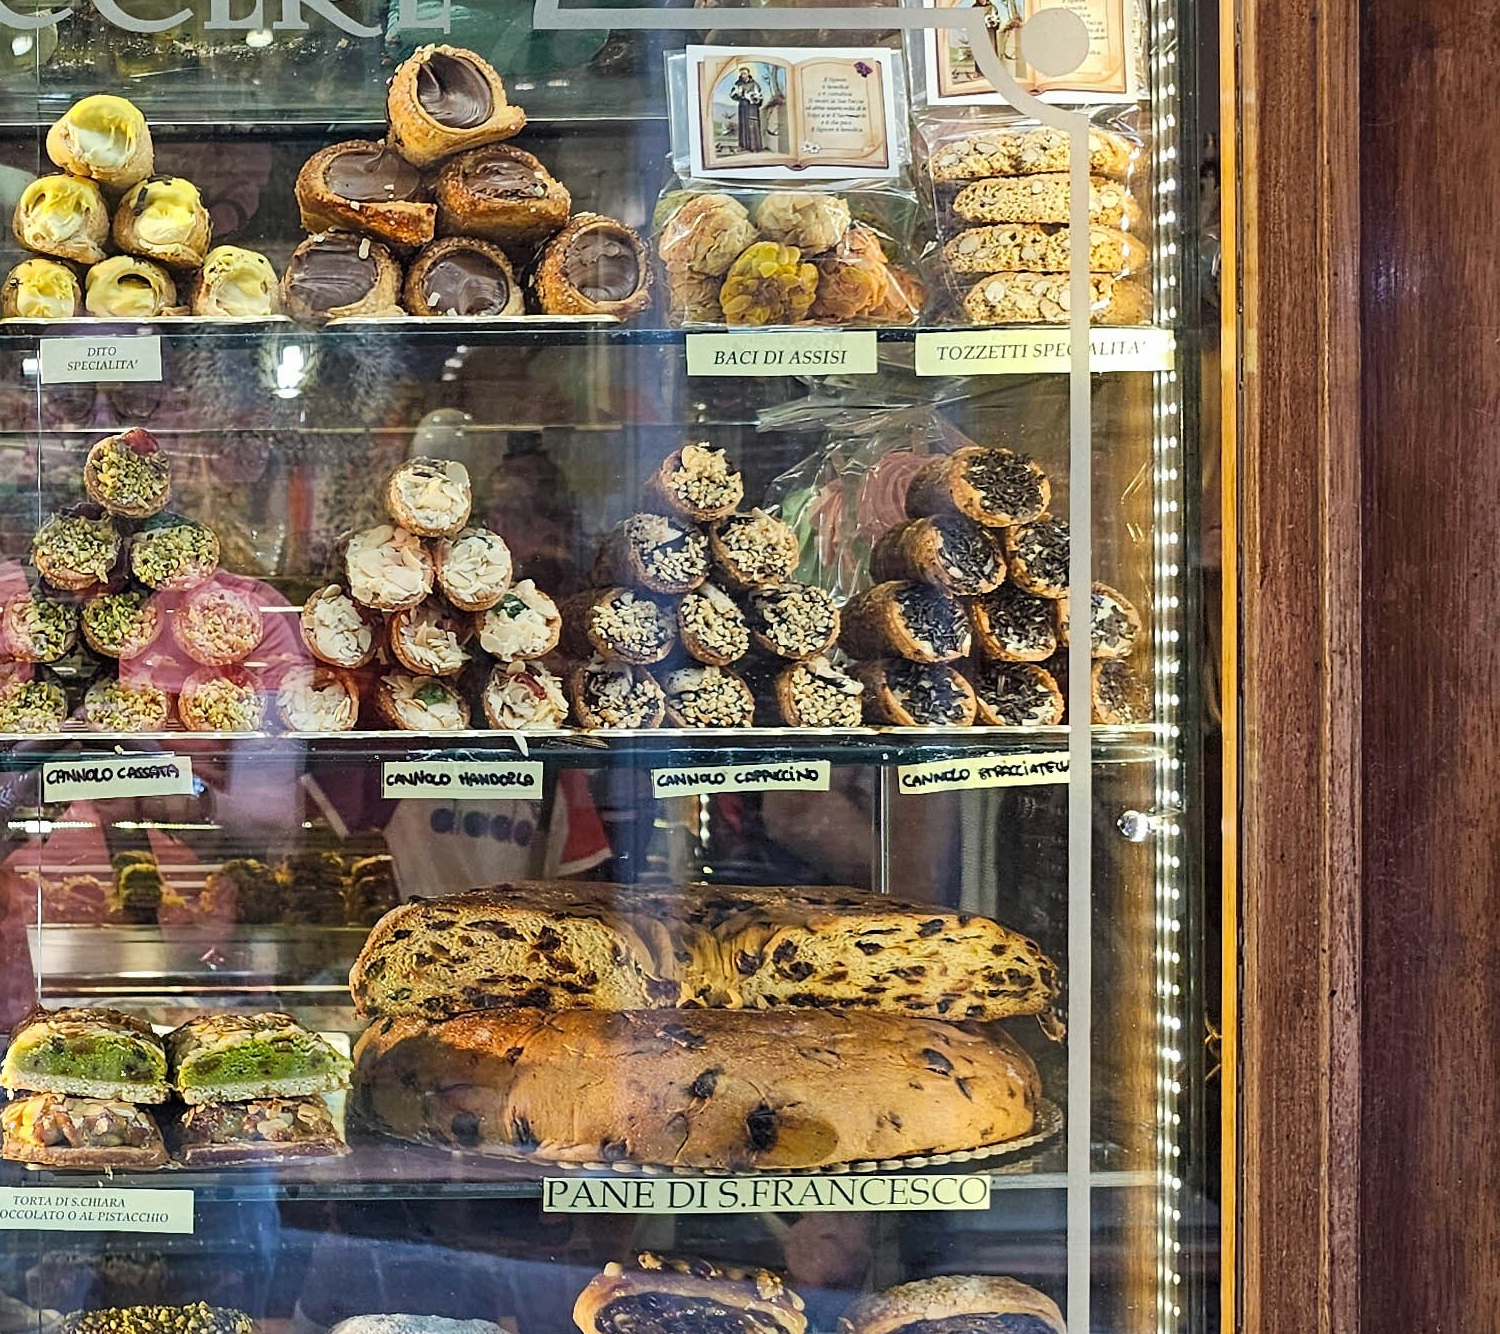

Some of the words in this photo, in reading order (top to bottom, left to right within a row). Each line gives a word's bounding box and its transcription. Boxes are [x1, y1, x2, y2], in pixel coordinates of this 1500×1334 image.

[87, 346, 117, 358] DITO
[713, 349, 758, 365] BACI
[763, 349, 784, 365] DI
[787, 348, 848, 365] ASSISI
[936, 343, 1028, 361] TOZZETTI
[66, 359, 139, 371] SPECIALITA'
[46, 768, 114, 785] CANNOLO
[116, 764, 180, 779] CASSATA
[385, 770, 452, 787] CANNOLO
[458, 771, 535, 787] MANDORLA
[656, 771, 726, 787] CANNOLO
[734, 766, 819, 784] CAPPUCCINO
[902, 768, 971, 788] CANNOLO
[546, 1179, 655, 1209] PANE
[668, 1178, 708, 1207] DI
[717, 1174, 989, 1208] S.FRANCESCO
[13, 1195, 52, 1206] TORTA
[55, 1196, 69, 1206] DI
[70, 1196, 126, 1208] S.CHIARA
[67, 1209, 77, 1220] O
[79, 1210, 95, 1221] AL
[97, 1211, 169, 1223] PISTACCHIO
